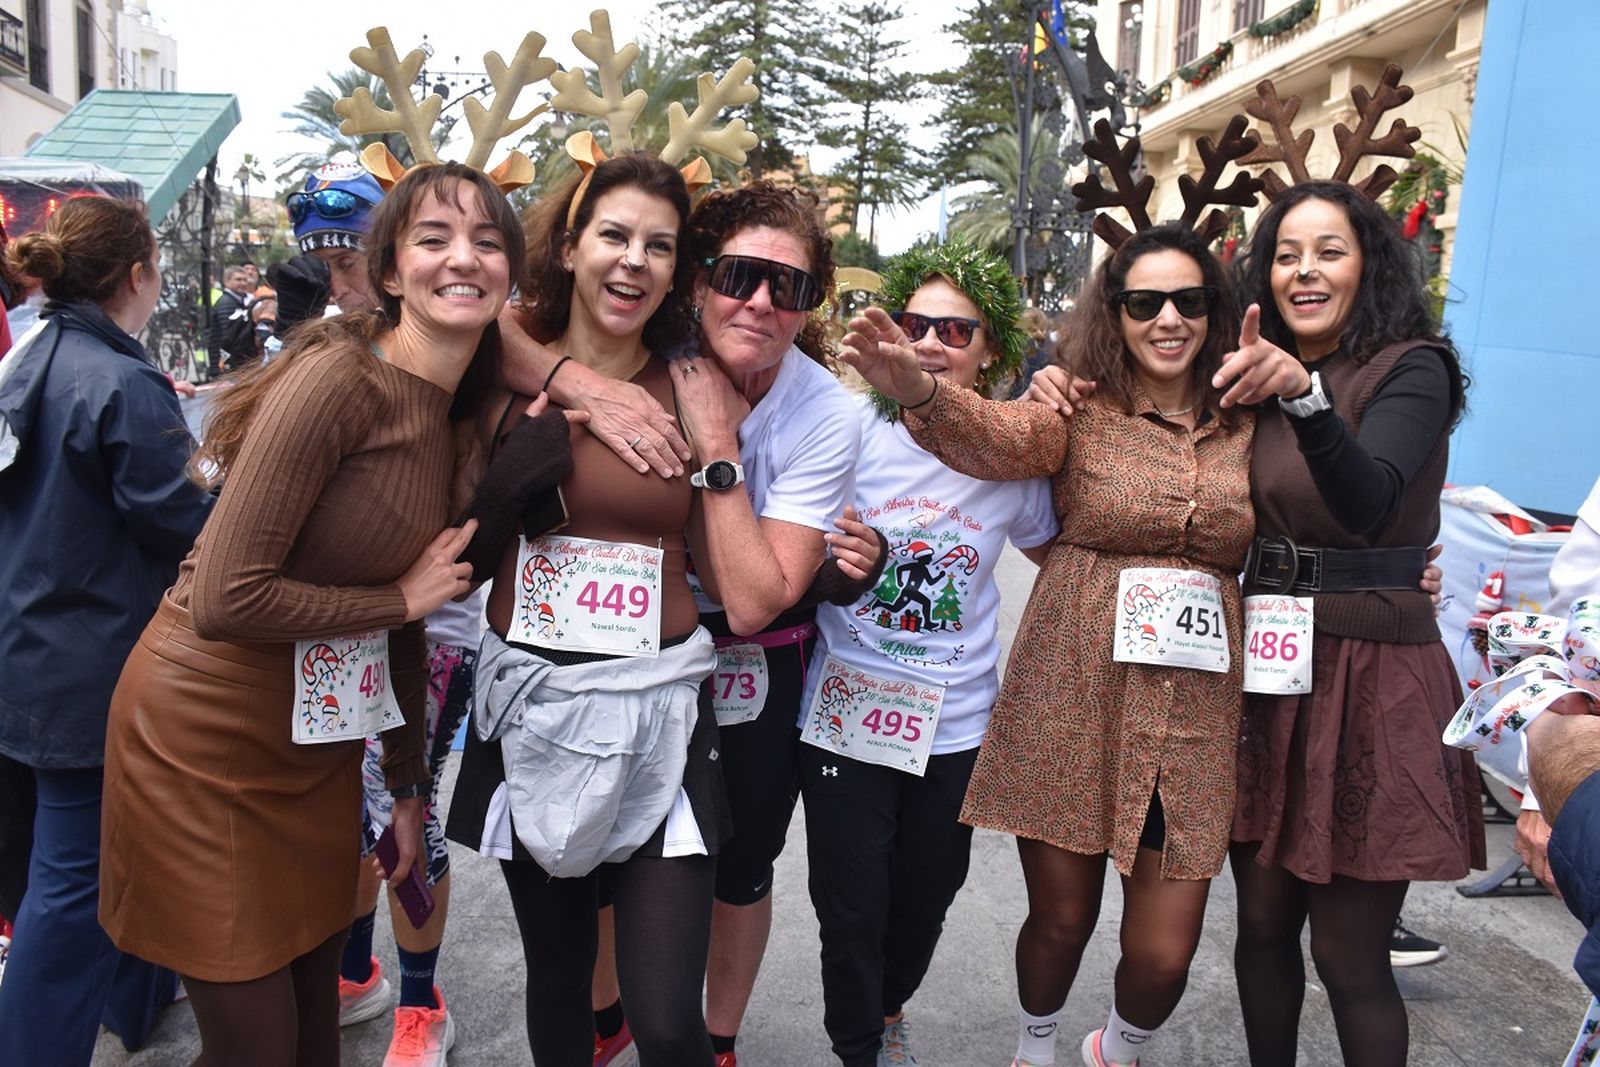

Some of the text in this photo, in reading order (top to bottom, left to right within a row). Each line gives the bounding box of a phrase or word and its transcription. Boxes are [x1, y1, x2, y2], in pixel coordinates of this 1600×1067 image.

[576, 580, 650, 619] 449
[591, 622, 637, 633] Nawal Sordo
[1175, 605, 1223, 640] 451
[1248, 630, 1299, 662] 486
[359, 660, 385, 698] 490
[861, 708, 923, 743] 495
